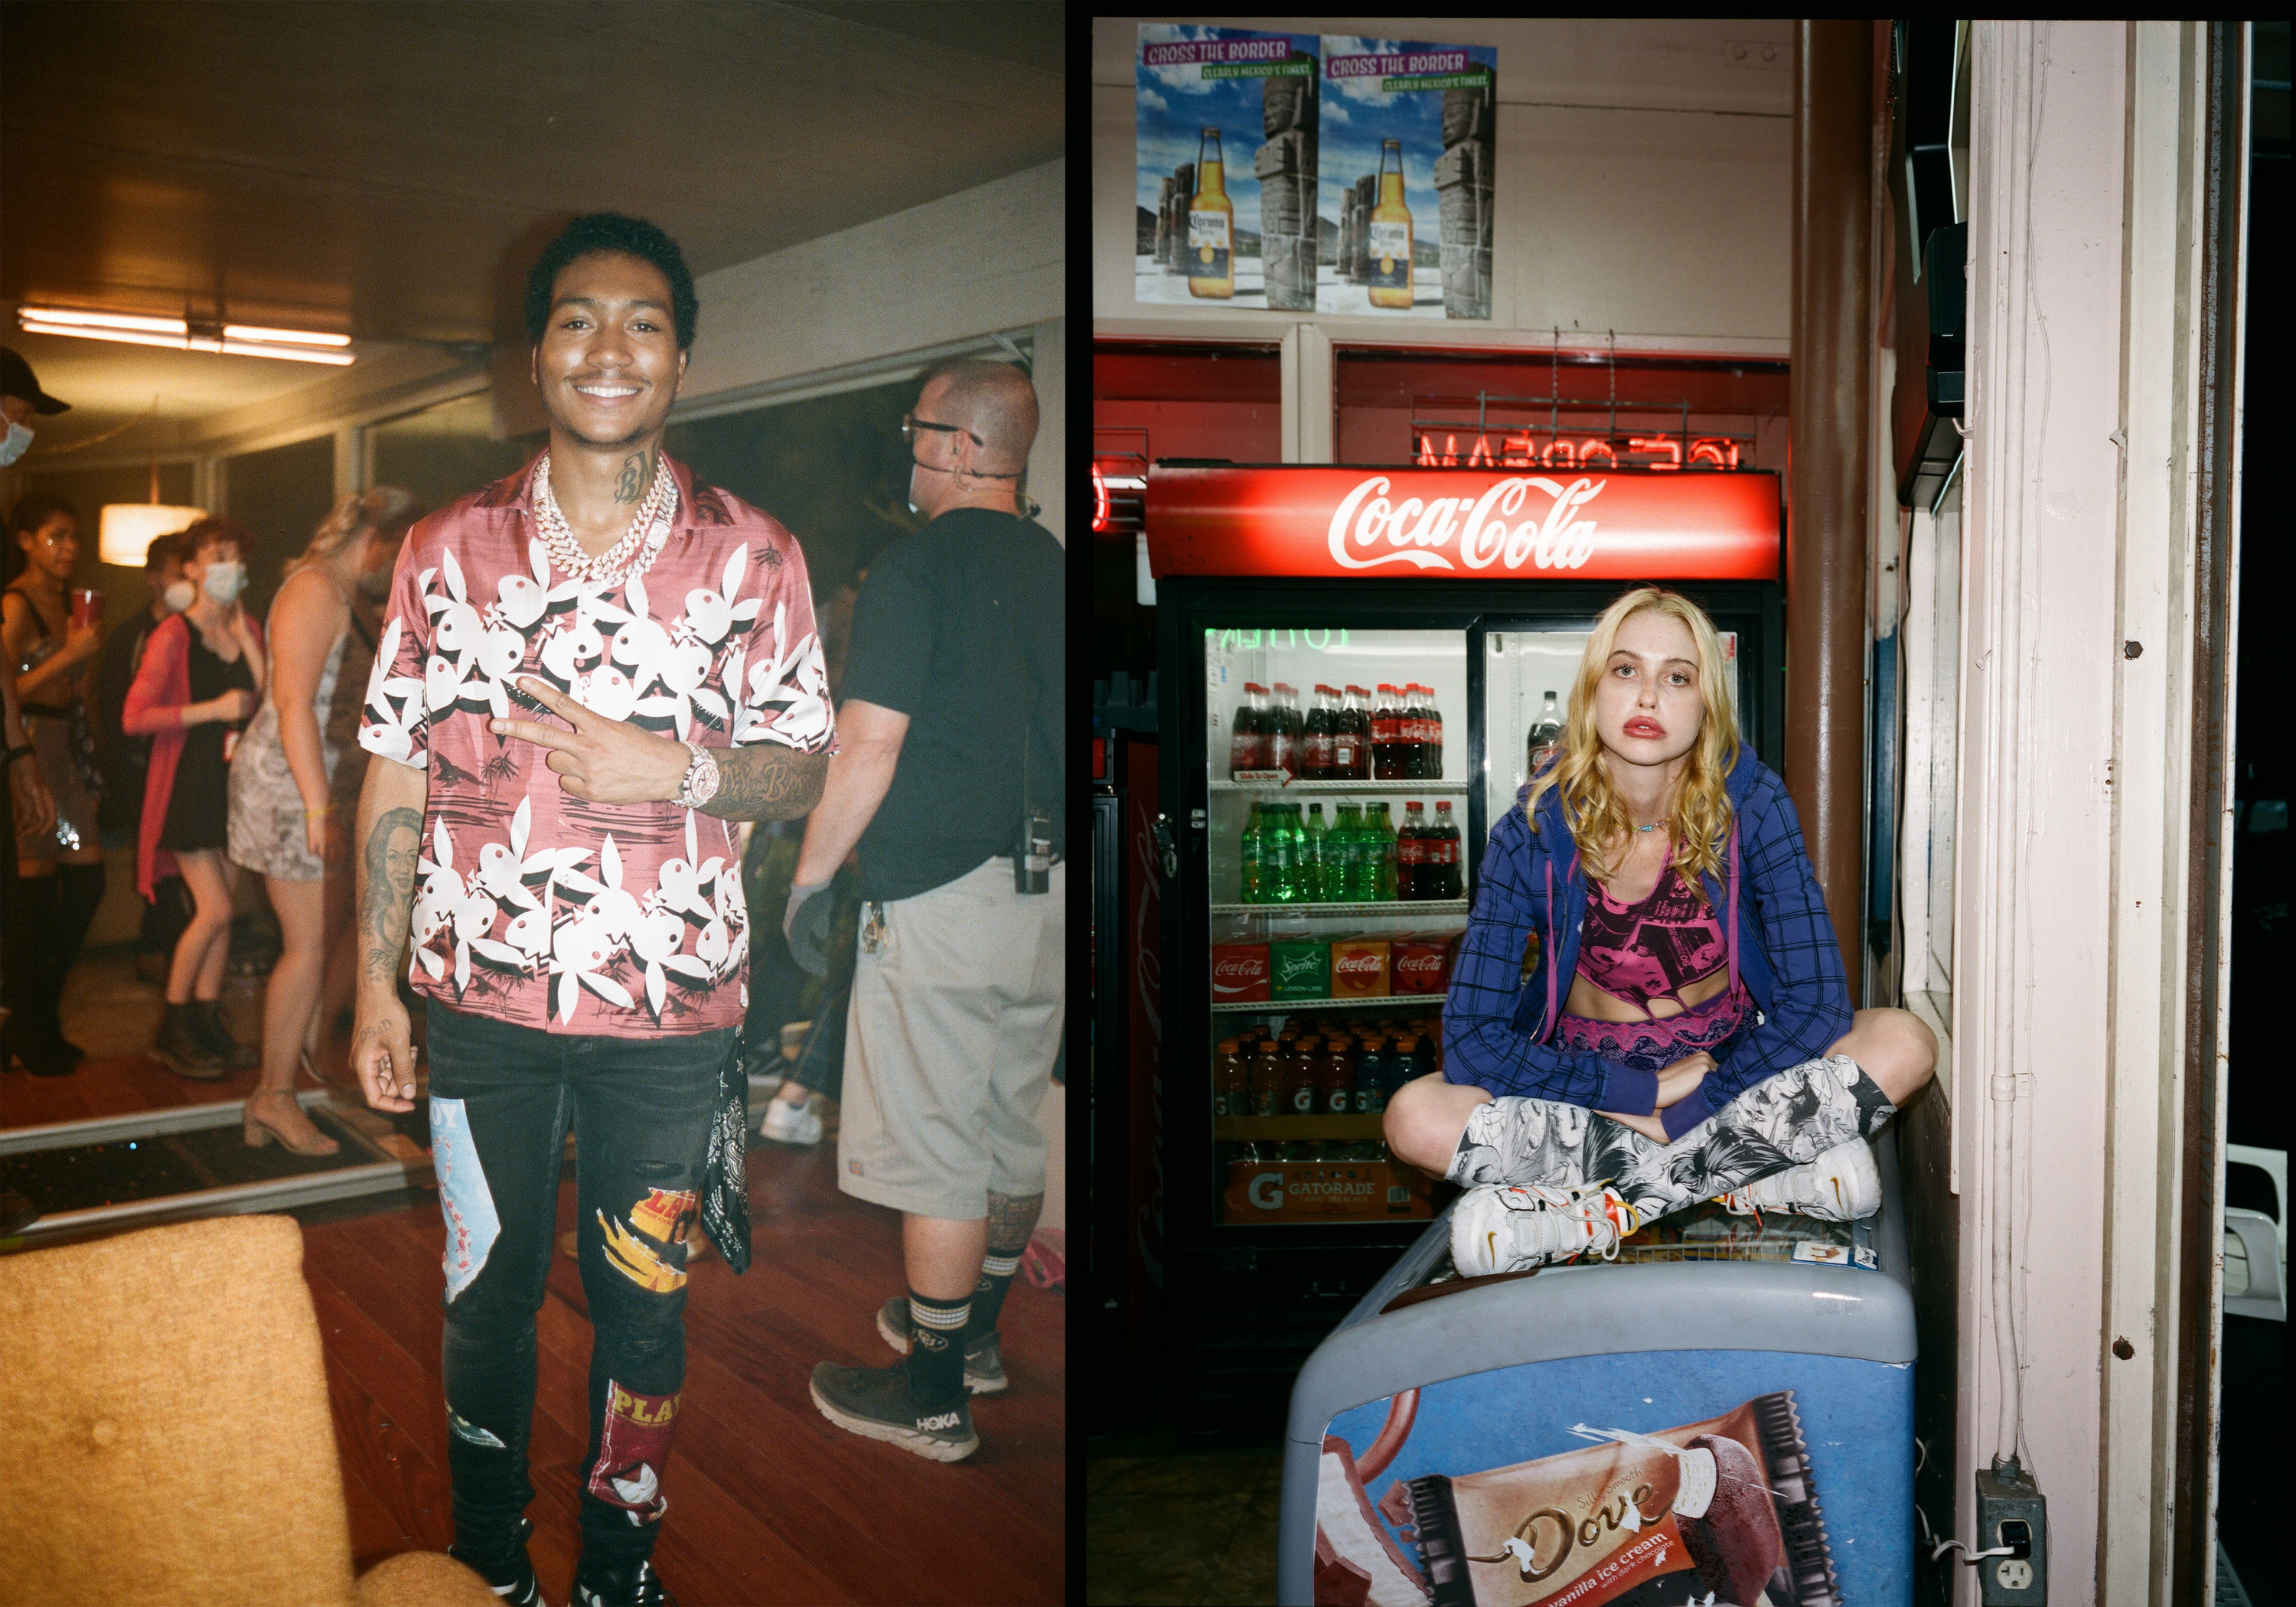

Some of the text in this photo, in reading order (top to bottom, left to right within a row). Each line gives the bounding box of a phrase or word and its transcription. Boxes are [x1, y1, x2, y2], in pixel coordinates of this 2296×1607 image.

[1149, 41, 1287, 63] CROSS THE BORDER
[1203, 67, 1238, 77] CLEARLY
[1241, 65, 1280, 77] MEXICO'S
[1331, 54, 1464, 76] CROSS THE BORDER
[1384, 79, 1418, 90] CLEARLY
[1328, 475, 1606, 570] Coca-Cola
[1215, 960, 1264, 976] Coca-Cola
[1283, 960, 1317, 974] Sprite
[1336, 955, 1384, 973] Coca-Cola
[1397, 955, 1444, 971] Coca-Cola
[1294, 1092, 1311, 1110] G
[1329, 1092, 1346, 1110] G
[1358, 1091, 1367, 1110] G
[1248, 1172, 1283, 1210] G
[1289, 1182, 1375, 1195] GATORADE
[916, 1412, 961, 1430] HOKA
[1577, 1467, 1642, 1510] Silky Smooth
[1466, 1482, 1676, 1583] Dove
[1548, 1532, 1668, 1607] vanilla ice cream
[1600, 1540, 1675, 1589] with dark chocolate
